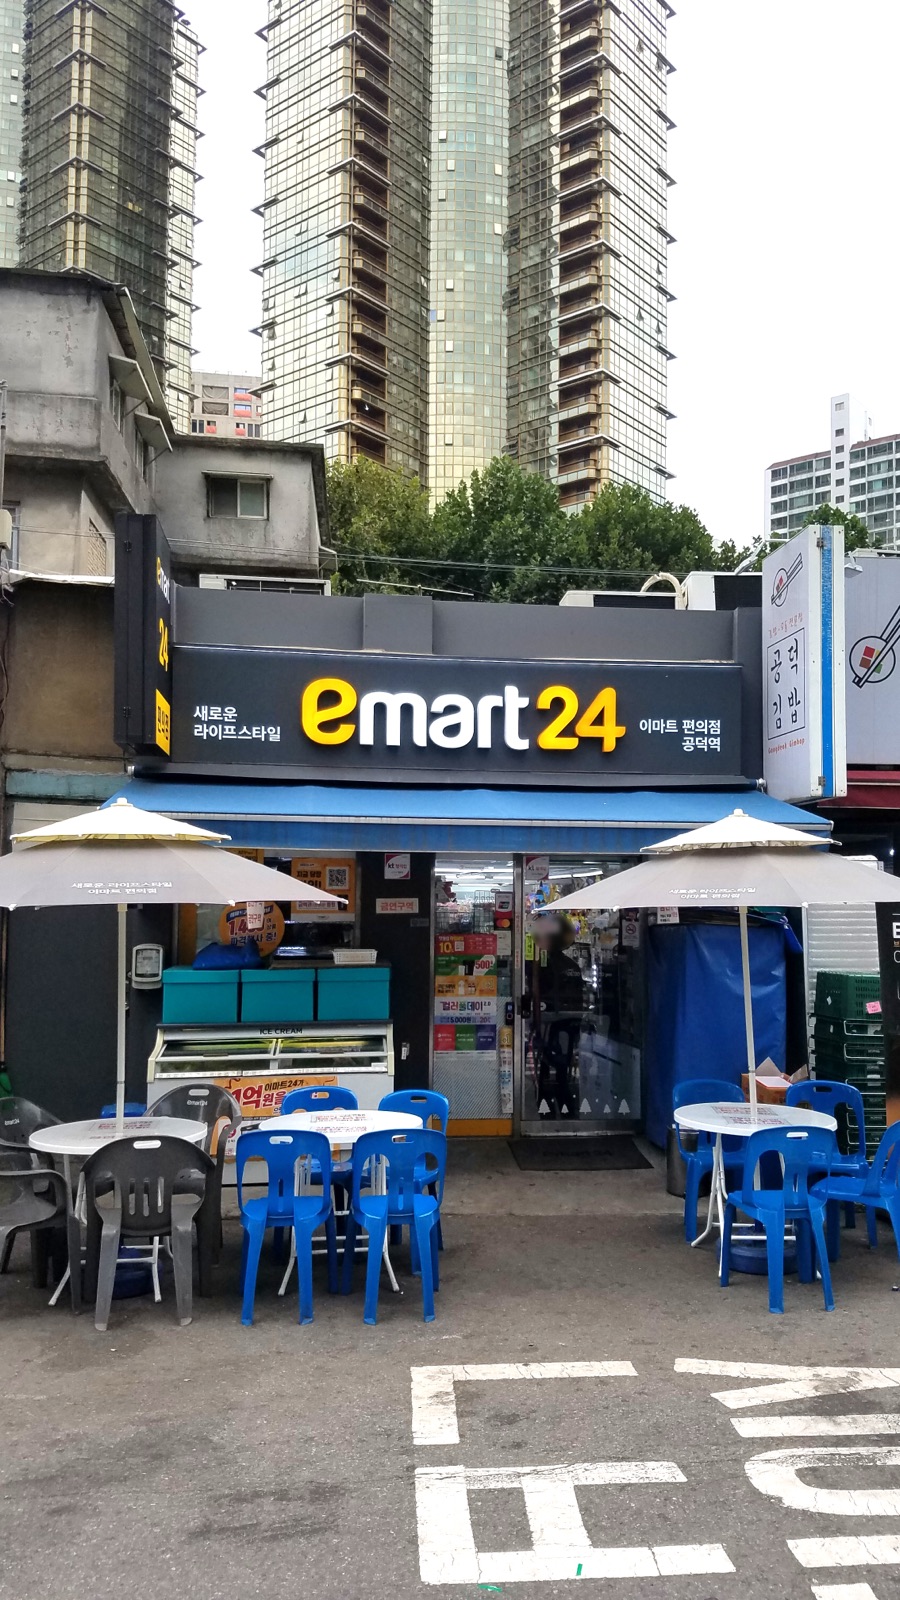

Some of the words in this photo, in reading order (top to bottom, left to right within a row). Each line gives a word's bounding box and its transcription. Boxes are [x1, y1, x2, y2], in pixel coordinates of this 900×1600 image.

[159, 618, 169, 671] 24
[193, 706, 237, 722] 새로운
[302, 678, 626, 752] emart24
[773, 687, 801, 729] 김밥
[194, 724, 280, 741] 라이프스타일
[639, 719, 678, 734] 이마트
[682, 719, 720, 734] 편의점
[682, 737, 720, 752] 공덕역
[381, 902, 414, 911] 금연구역
[275, 1027, 303, 1035] CREAM
[265, 1080, 304, 1091] 이마트24가
